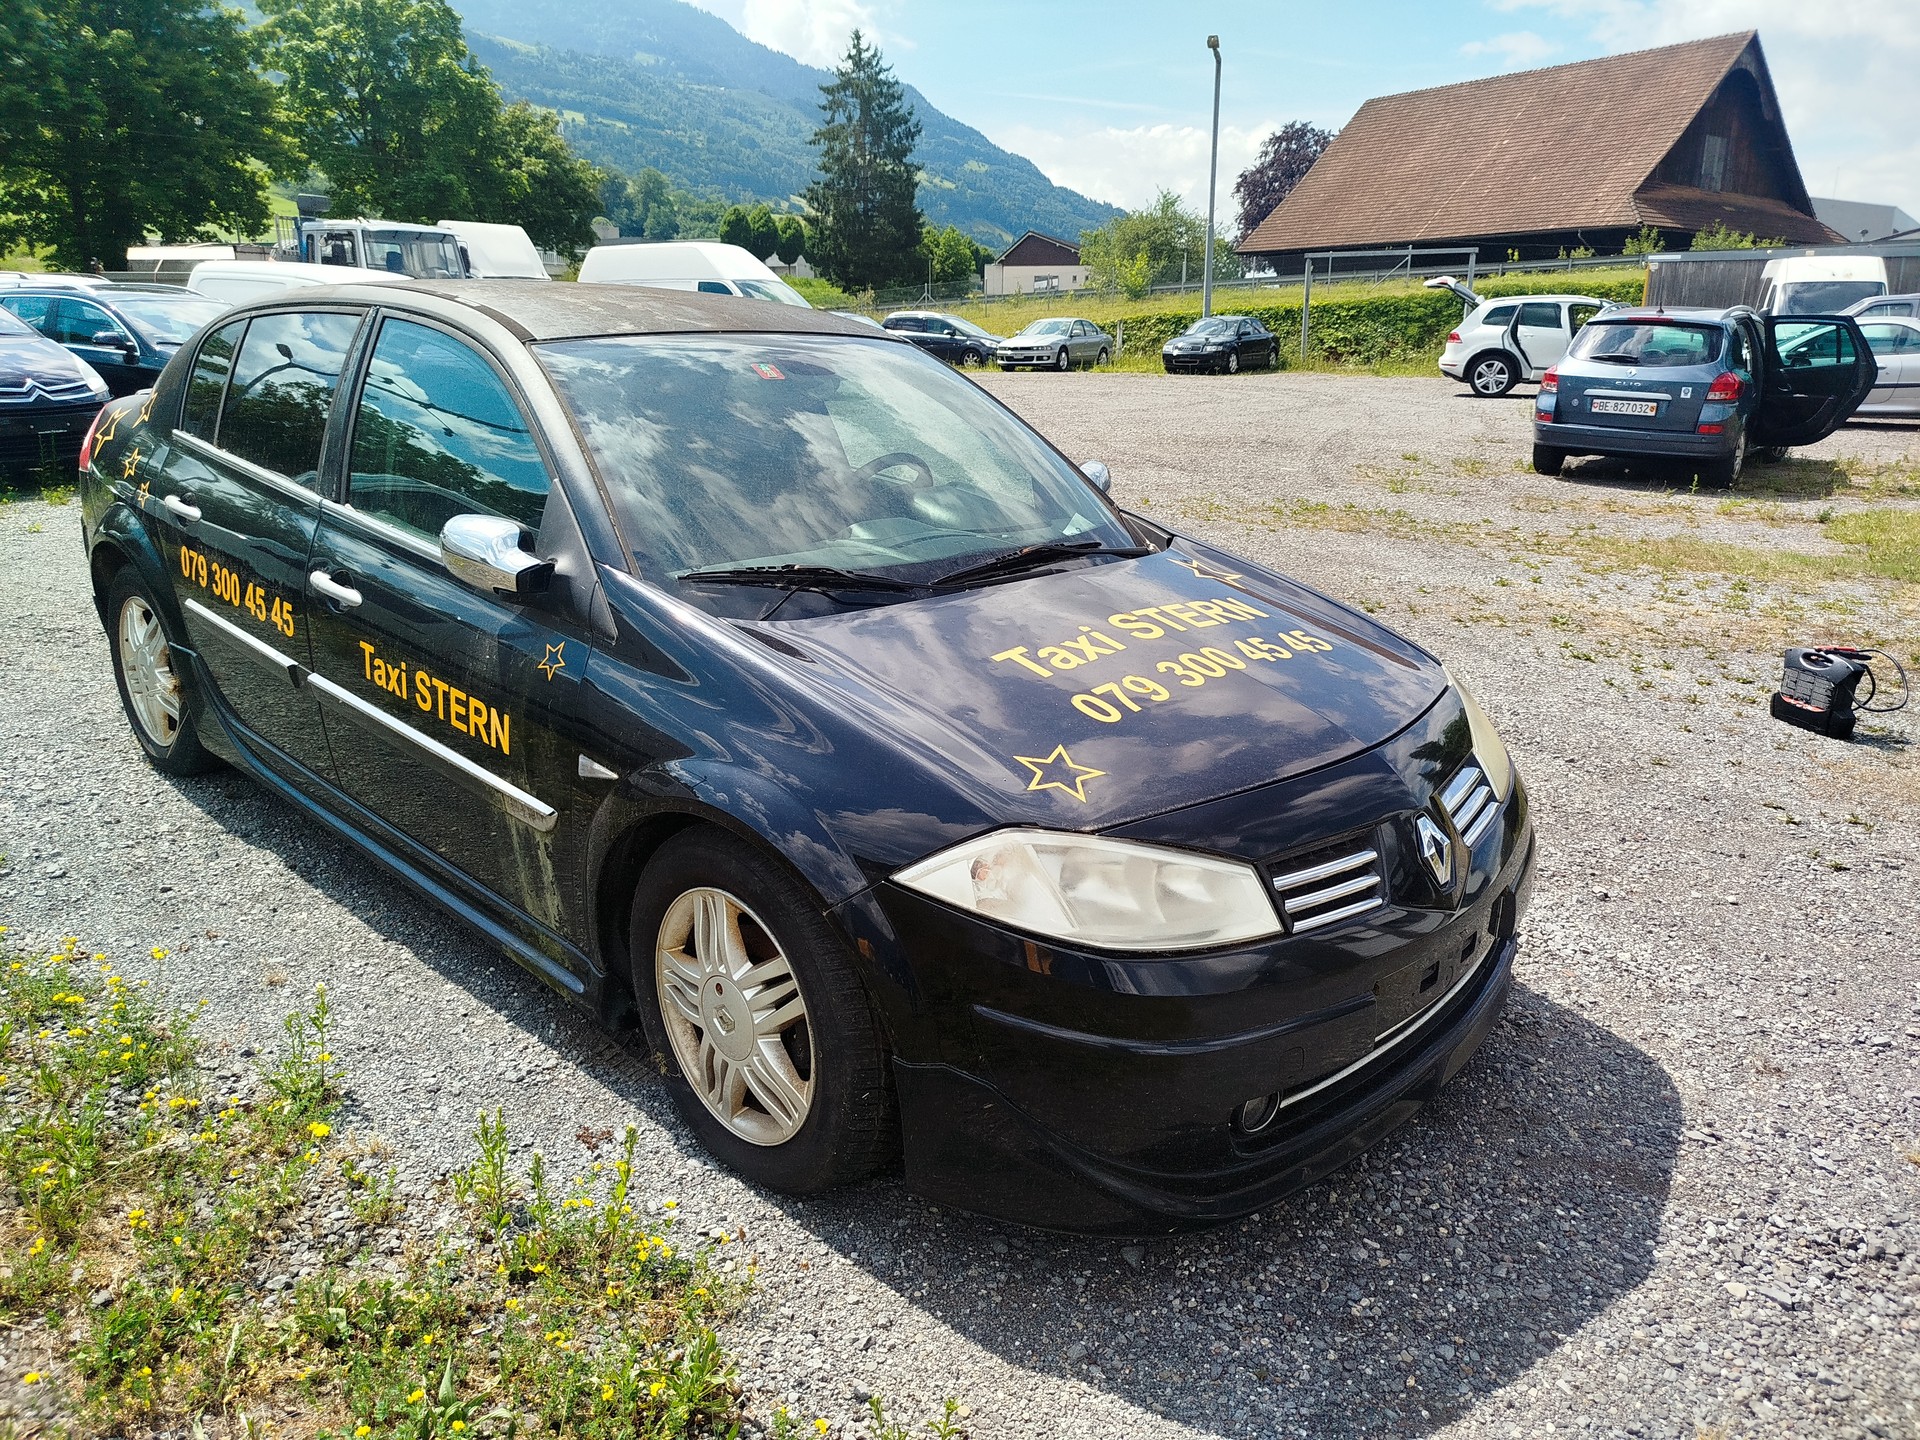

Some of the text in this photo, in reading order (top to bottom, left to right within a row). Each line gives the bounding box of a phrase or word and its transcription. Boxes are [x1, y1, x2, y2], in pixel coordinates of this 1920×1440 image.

[181, 545, 295, 637] 079 300 45 45
[990, 597, 1270, 678] Taxi STERN
[1071, 630, 1334, 723] 079 300 45 45
[359, 640, 510, 756] Taxi STERN
